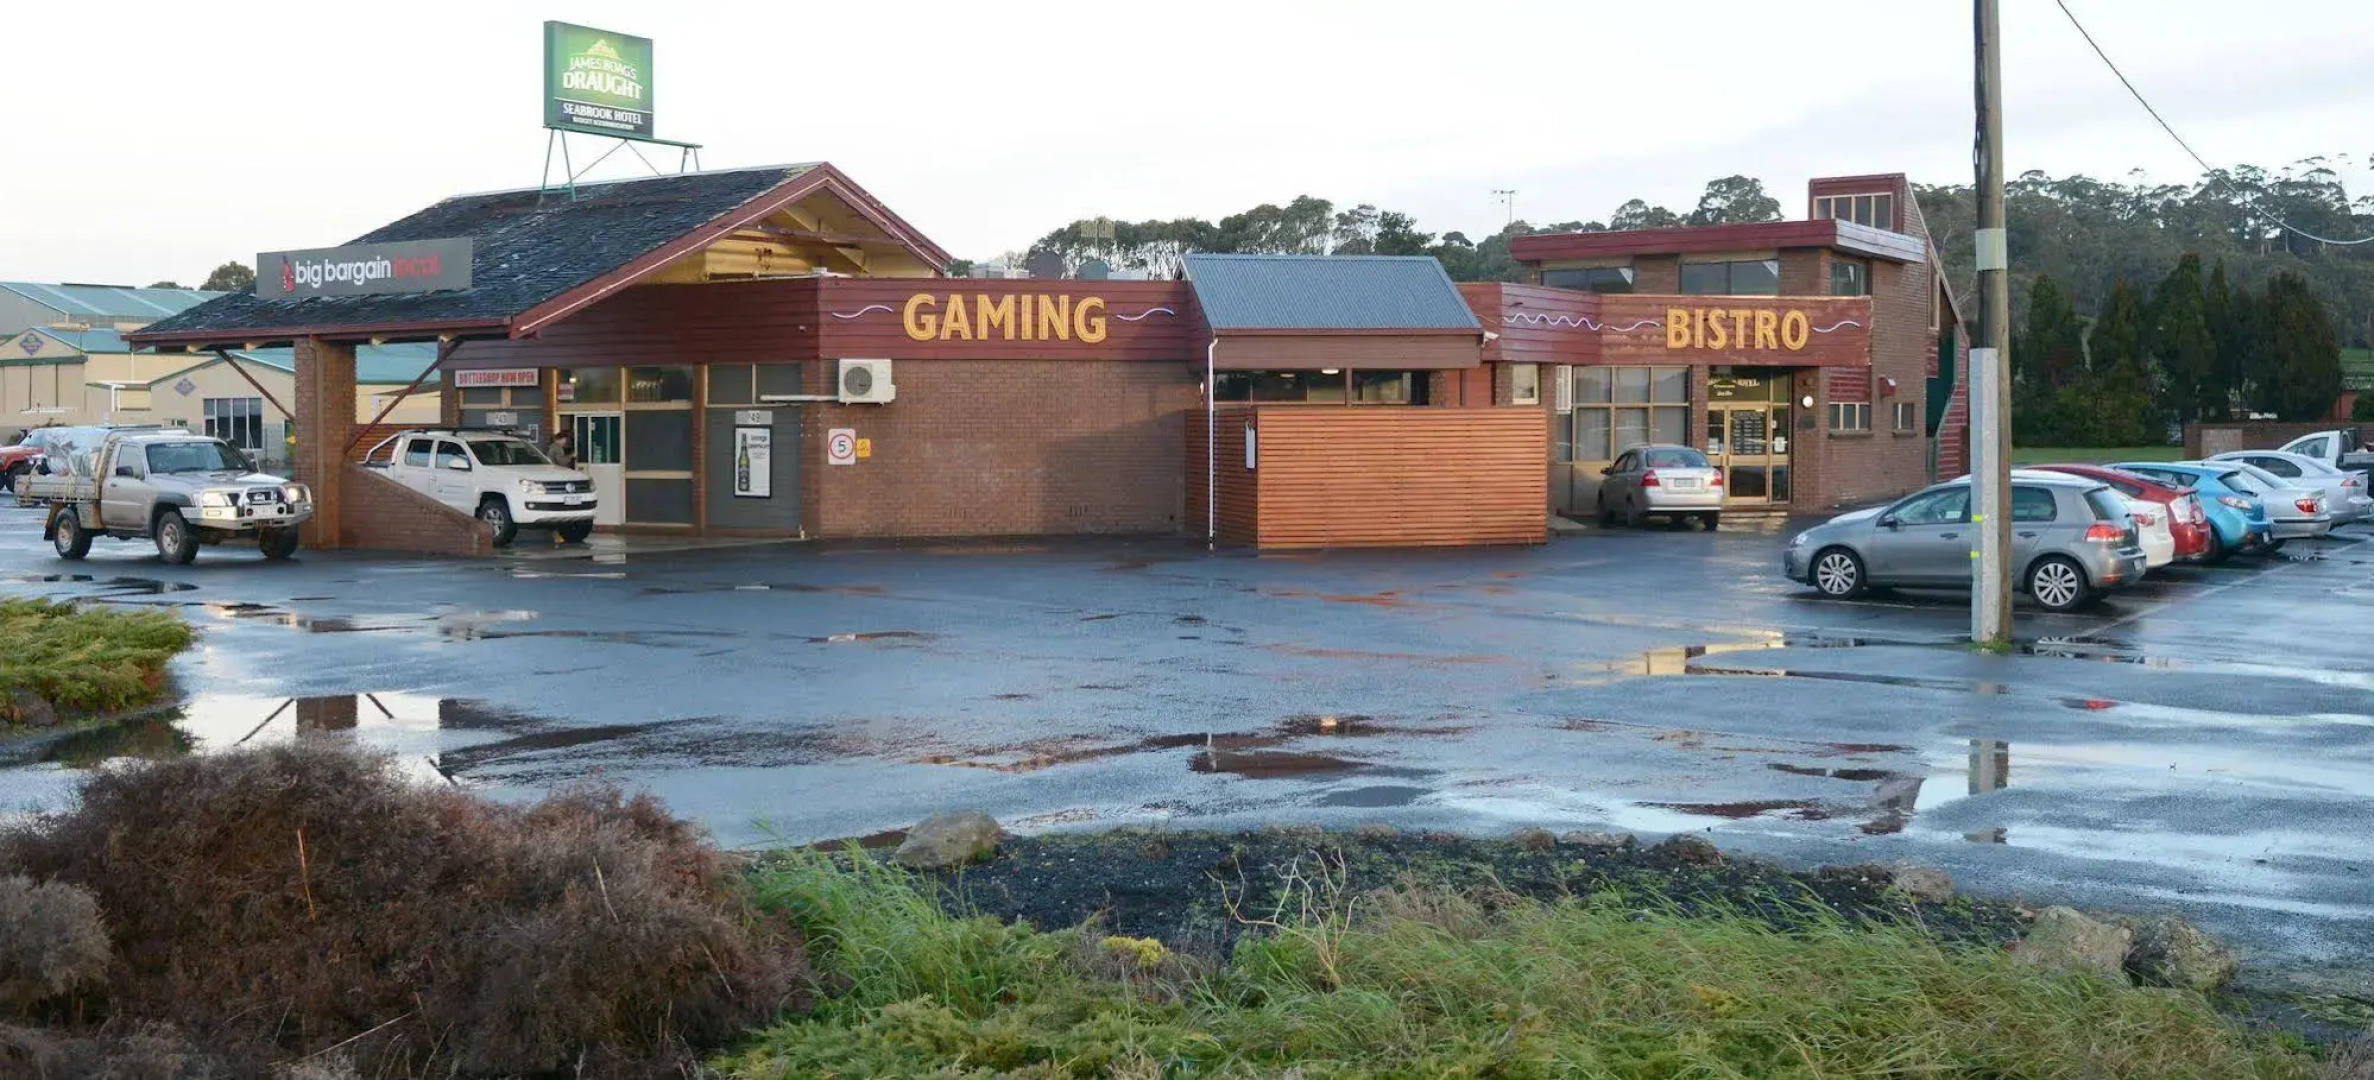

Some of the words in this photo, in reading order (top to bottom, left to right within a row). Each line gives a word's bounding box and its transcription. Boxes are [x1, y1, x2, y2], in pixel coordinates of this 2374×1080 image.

[570, 56, 601, 71] JAMES
[562, 71, 643, 99] DRAUGHT
[563, 103, 613, 120] SEABROOK
[614, 109, 643, 124] HOTEL
[295, 260, 322, 288] big
[325, 255, 392, 286] bargain
[394, 252, 441, 279] local
[902, 293, 1106, 344] GAMING
[1666, 308, 1810, 350] BISTRO
[518, 370, 535, 383] OPEN
[838, 440, 847, 453] 5
